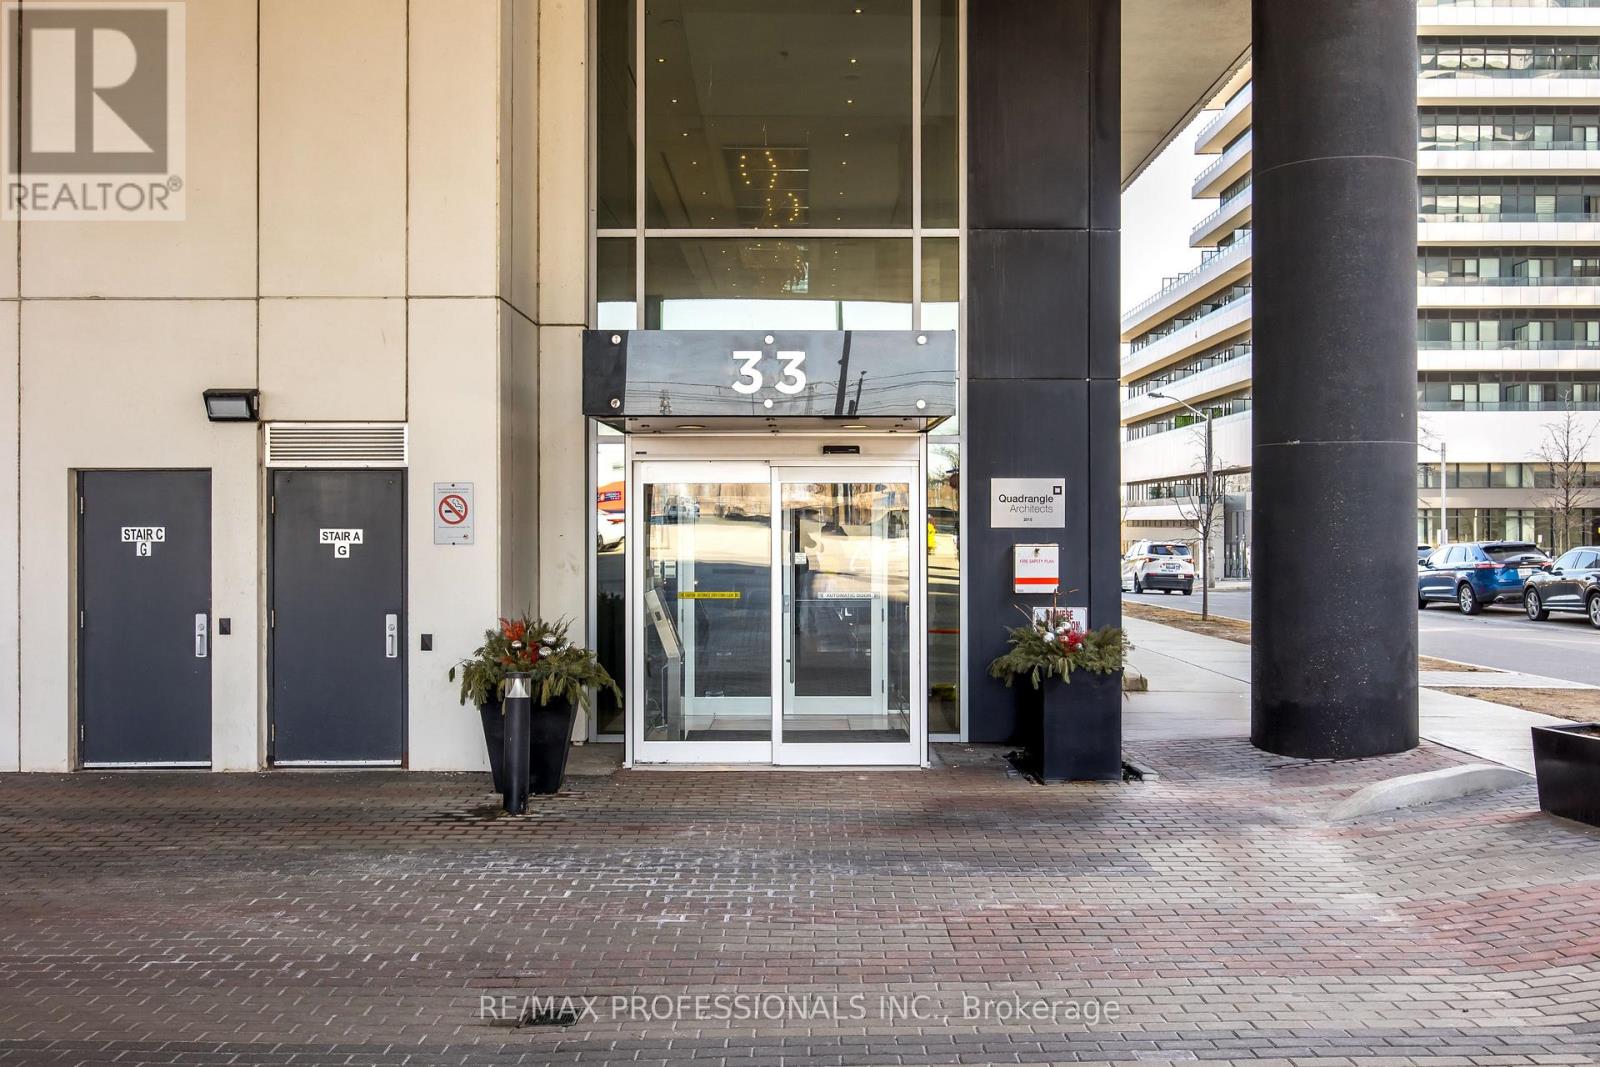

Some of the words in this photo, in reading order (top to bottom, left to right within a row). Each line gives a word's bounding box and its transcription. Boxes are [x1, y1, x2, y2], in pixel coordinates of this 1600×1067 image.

[731, 350, 807, 395] 33
[998, 494, 1054, 505] Quadrangle
[1010, 504, 1054, 514] Architects
[123, 528, 153, 541] STAIR
[155, 528, 163, 541] C
[322, 531, 351, 541] STAIR
[353, 531, 361, 541] A
[140, 543, 147, 556] G
[337, 545, 347, 556] G
